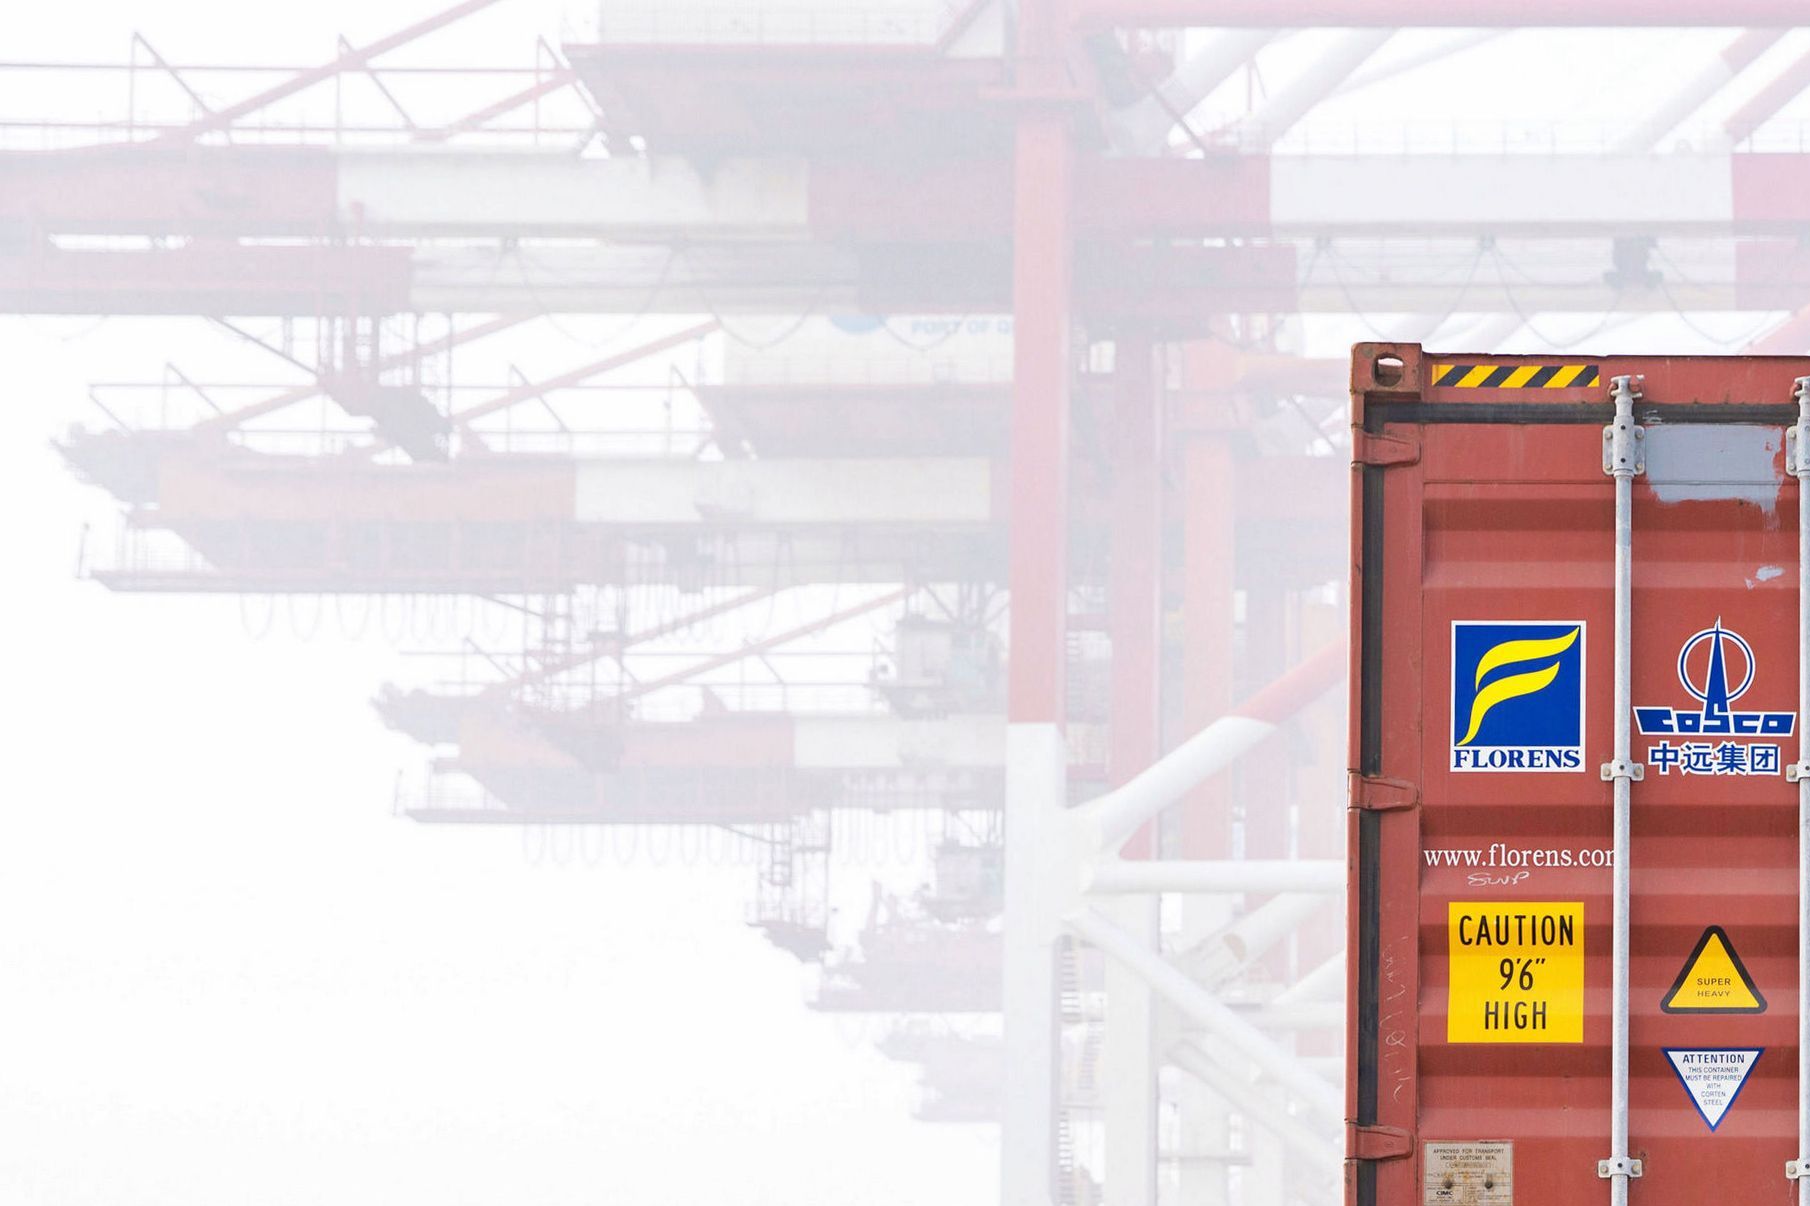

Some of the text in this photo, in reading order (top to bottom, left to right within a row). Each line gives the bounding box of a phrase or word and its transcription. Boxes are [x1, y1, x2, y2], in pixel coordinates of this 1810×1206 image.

[1634, 702, 1797, 736] COSCO
[1454, 749, 1580, 769] FLORENS
[1649, 742, 1781, 776] 中远集团
[1459, 914, 1575, 947] CAUTION
[1696, 977, 1731, 986] SUPER
[1696, 989, 1731, 998] HEAVY
[1484, 1001, 1548, 1030] HIGH
[1682, 1053, 1745, 1064] ATTENTION
